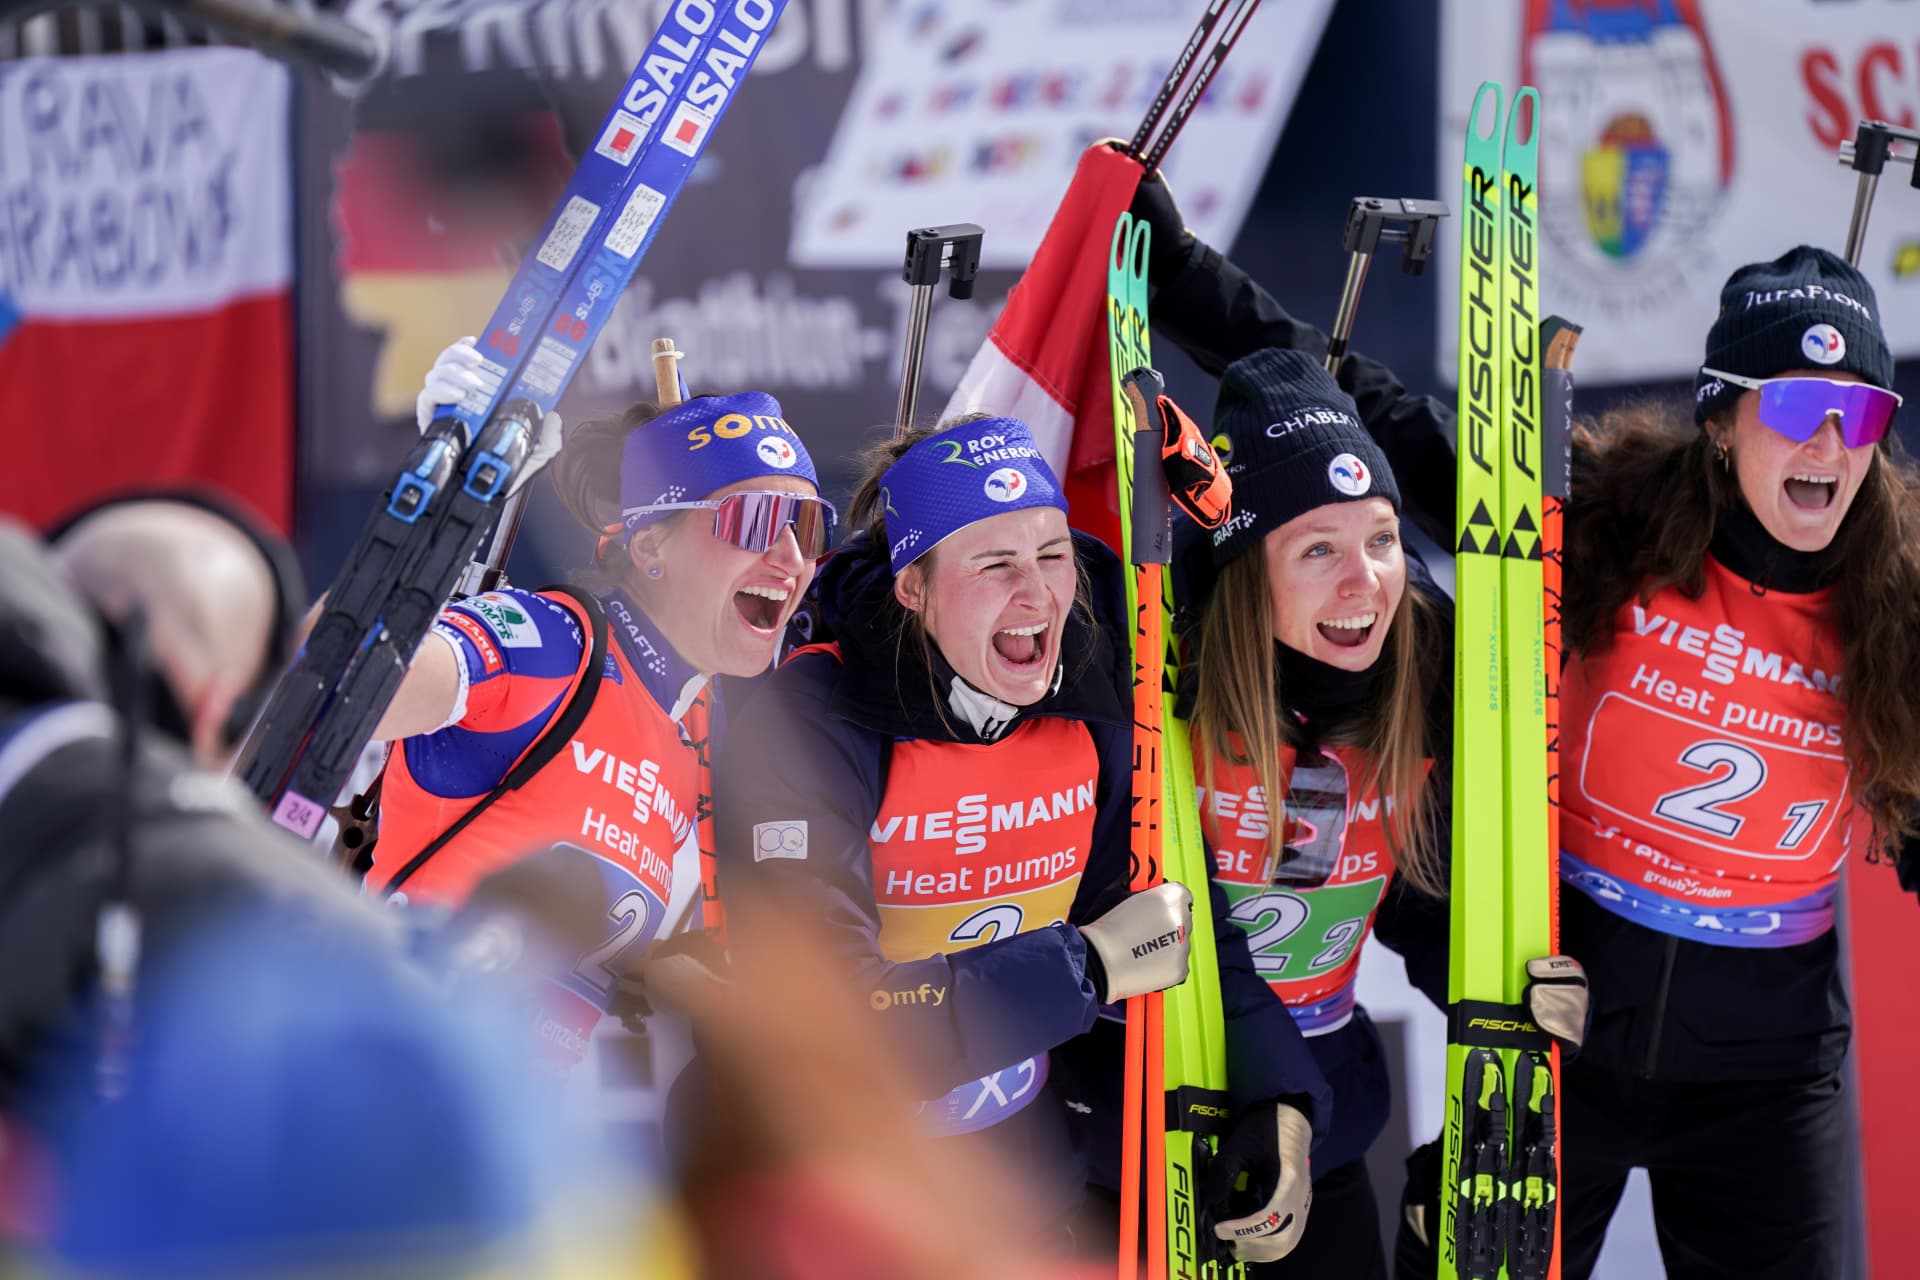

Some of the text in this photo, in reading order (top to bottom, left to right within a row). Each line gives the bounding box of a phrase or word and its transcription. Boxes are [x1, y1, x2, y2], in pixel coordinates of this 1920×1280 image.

[624, 0, 716, 124] SALO
[686, 0, 774, 117] SALO
[1800, 44, 1920, 150] SC
[20, 66, 212, 178] RAVA
[1469, 166, 1494, 476] FISCHER
[1510, 173, 1535, 481] FISCHER
[967, 435, 1006, 454] ROY
[1213, 517, 1241, 546] CRAFT
[610, 600, 658, 658] CRAFT
[1632, 605, 1843, 694] VIESSMAN
[1630, 663, 1843, 747] Heat pumps
[572, 740, 692, 845] VIESSMANN
[869, 779, 1095, 856] VIESSMANN
[1652, 739, 1768, 840] 2
[1776, 799, 1829, 850] 1
[581, 807, 674, 899] Heat pump
[886, 846, 1077, 896] Heat pumps
[573, 889, 649, 998] 2
[1227, 892, 1372, 973] 2 2
[870, 981, 947, 1011] omfy
[1468, 1017, 1538, 1033] FISCHE
[1189, 1103, 1232, 1119] FISCHE
[1172, 1161, 1193, 1280] FISCH
[1444, 1093, 1461, 1265] FISCHER
